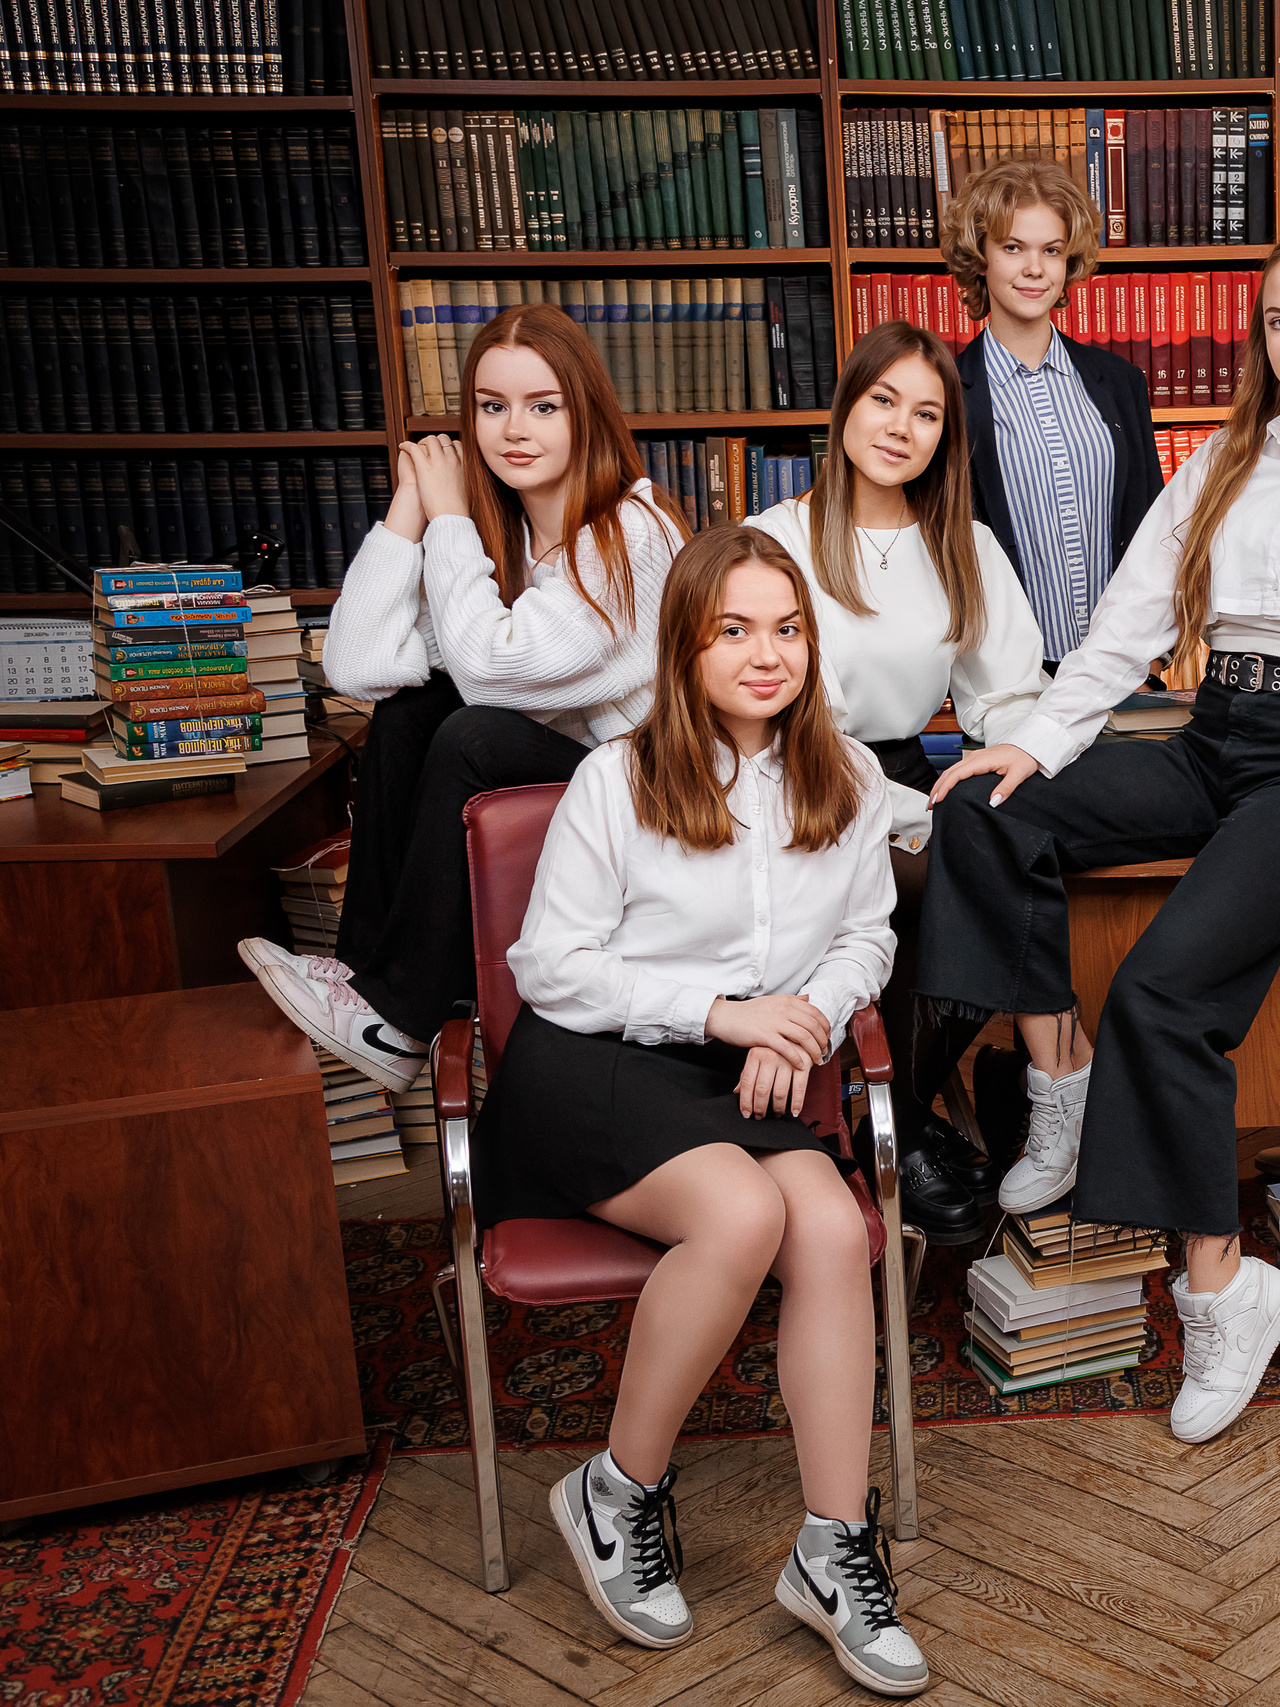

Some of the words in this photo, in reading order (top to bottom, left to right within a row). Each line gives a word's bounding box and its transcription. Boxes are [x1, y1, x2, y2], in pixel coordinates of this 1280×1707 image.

[1249, 120, 1270, 130] КИНО
[843, 122, 851, 177] МУЗЫКАЛЬНАЯ
[850, 122, 859, 178] ЭНЦИКЛОПЕДИЯ
[857, 121, 866, 177] МУЗЫКАЛЬНАЯ
[864, 121, 873, 177] ЭНЦИКЛОПЕДИЯ
[871, 121, 880, 176] МУЗЫКАЛЬНАЯ
[878, 121, 887, 176] ЭНЦИКЛОПЕДИЯ
[886, 121, 896, 176] МУЗЫКАЛЬНАЯ
[893, 121, 903, 176] ЭНЦИКЛОПЕДИЯ
[901, 121, 910, 176] МУЗЫКАЛЬНАЯ
[907, 121, 917, 177] ЭНЦИКЛОПЕДИЯ
[916, 122, 925, 177] МУЗЫКАЛЬНАЯ
[922, 122, 932, 178] ЭНЦИКЛОПЕДИЯ
[787, 184, 800, 226] Курорты
[1157, 369, 1167, 379] 16
[1176, 369, 1185, 379] 17
[1197, 368, 1206, 378] 18
[60, 676, 71, 684] 23
[78, 665, 88, 673] 17
[26, 687, 37, 695] 28
[149, 706, 168, 714] ПЕХОВ
[179, 719, 224, 733] ПЕРУМОВ
[224, 717, 243, 728] Ник
[177, 739, 221, 754] ПЕРУМОВ
[221, 738, 242, 750] Ник
